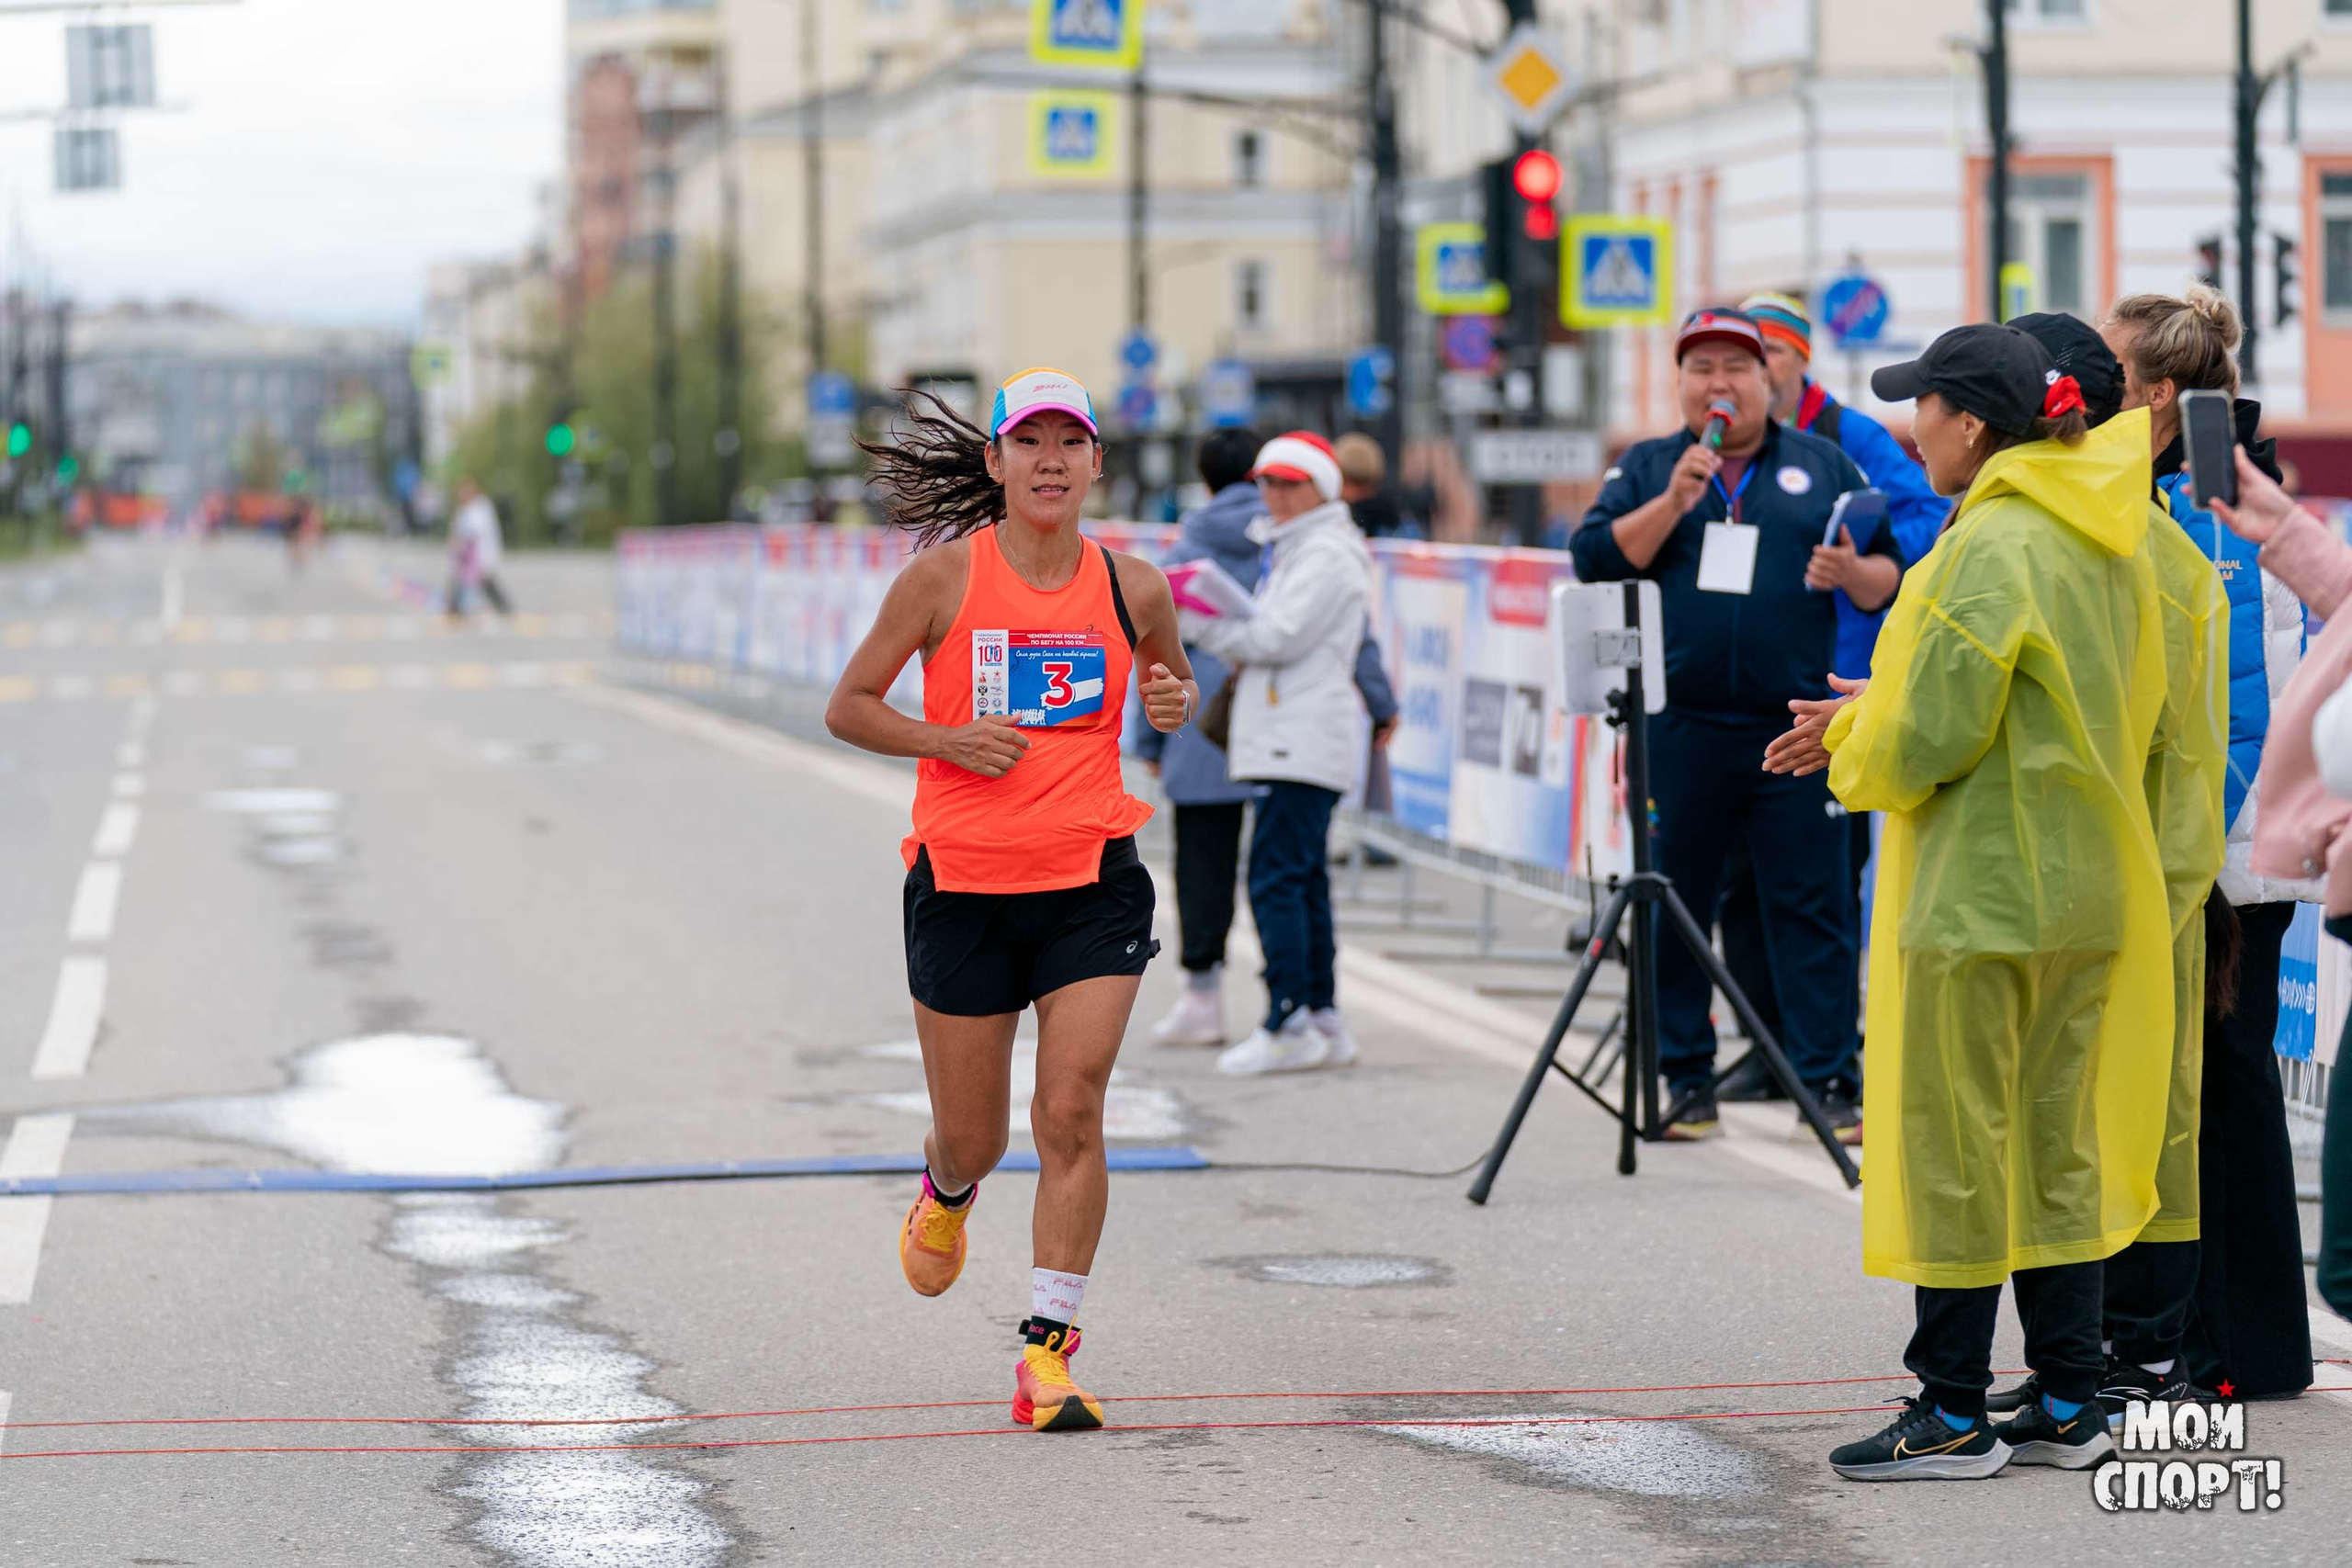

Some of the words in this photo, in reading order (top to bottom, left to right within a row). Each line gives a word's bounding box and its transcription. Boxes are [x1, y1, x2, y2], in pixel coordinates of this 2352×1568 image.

[2214, 559, 2243, 570] ONAL
[978, 644, 1002, 666] 100
[1044, 662, 1074, 708] 3
[1054, 1279, 1082, 1288] FILA
[1050, 1298, 1076, 1309] FILA
